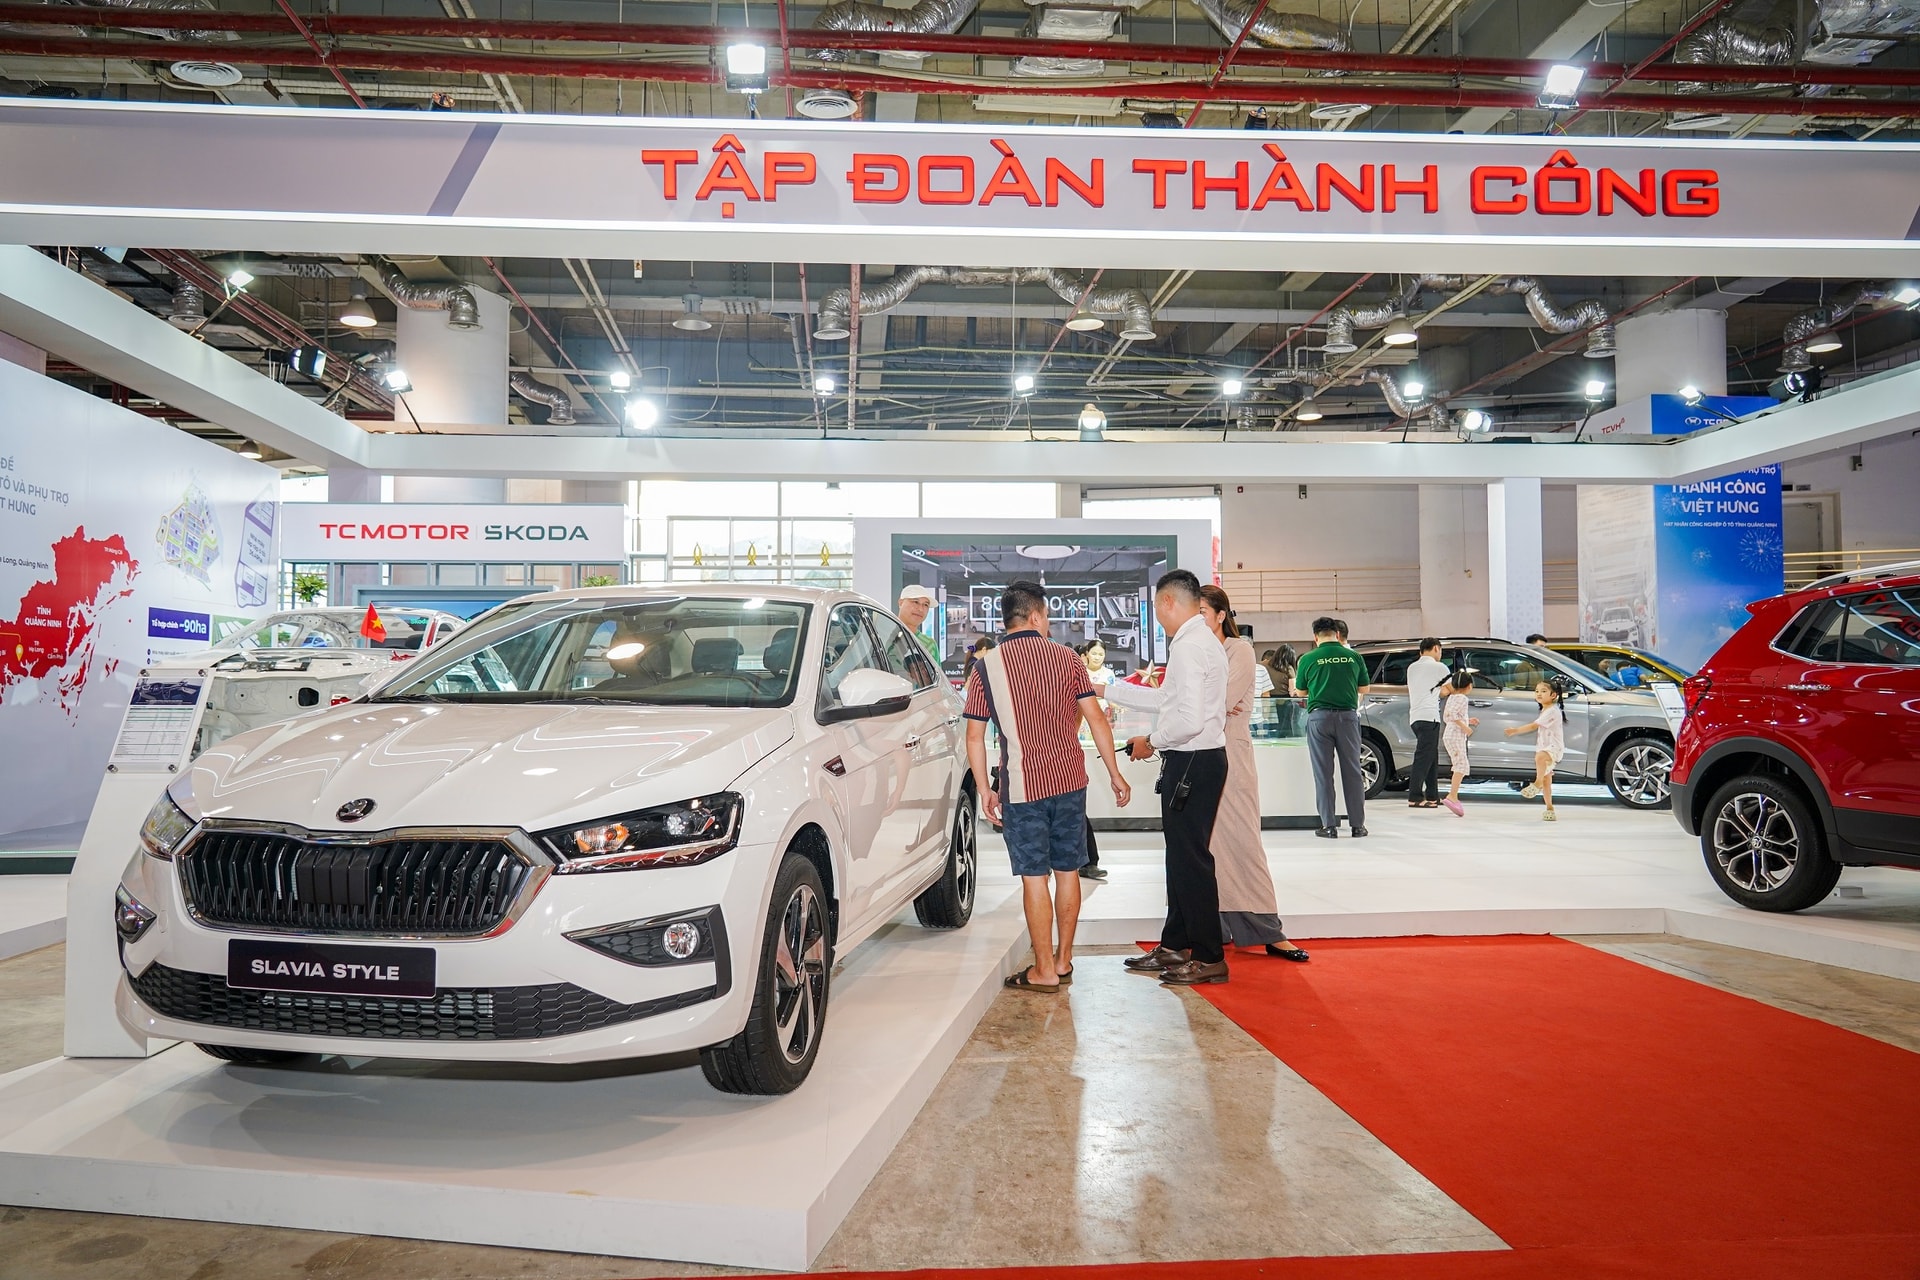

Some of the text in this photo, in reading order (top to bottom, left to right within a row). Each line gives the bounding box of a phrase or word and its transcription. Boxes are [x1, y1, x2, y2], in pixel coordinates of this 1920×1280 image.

[641, 134, 1720, 218] TẬP ĐOÀN THÀNH CÔNG
[28, 484, 48, 502] PHỤ
[50, 489, 69, 507] TRỢ
[1724, 478, 1767, 495] CÔNG
[1680, 497, 1760, 516] VIỆT HƯNG
[251, 959, 400, 981] SLAVIA STYLE
